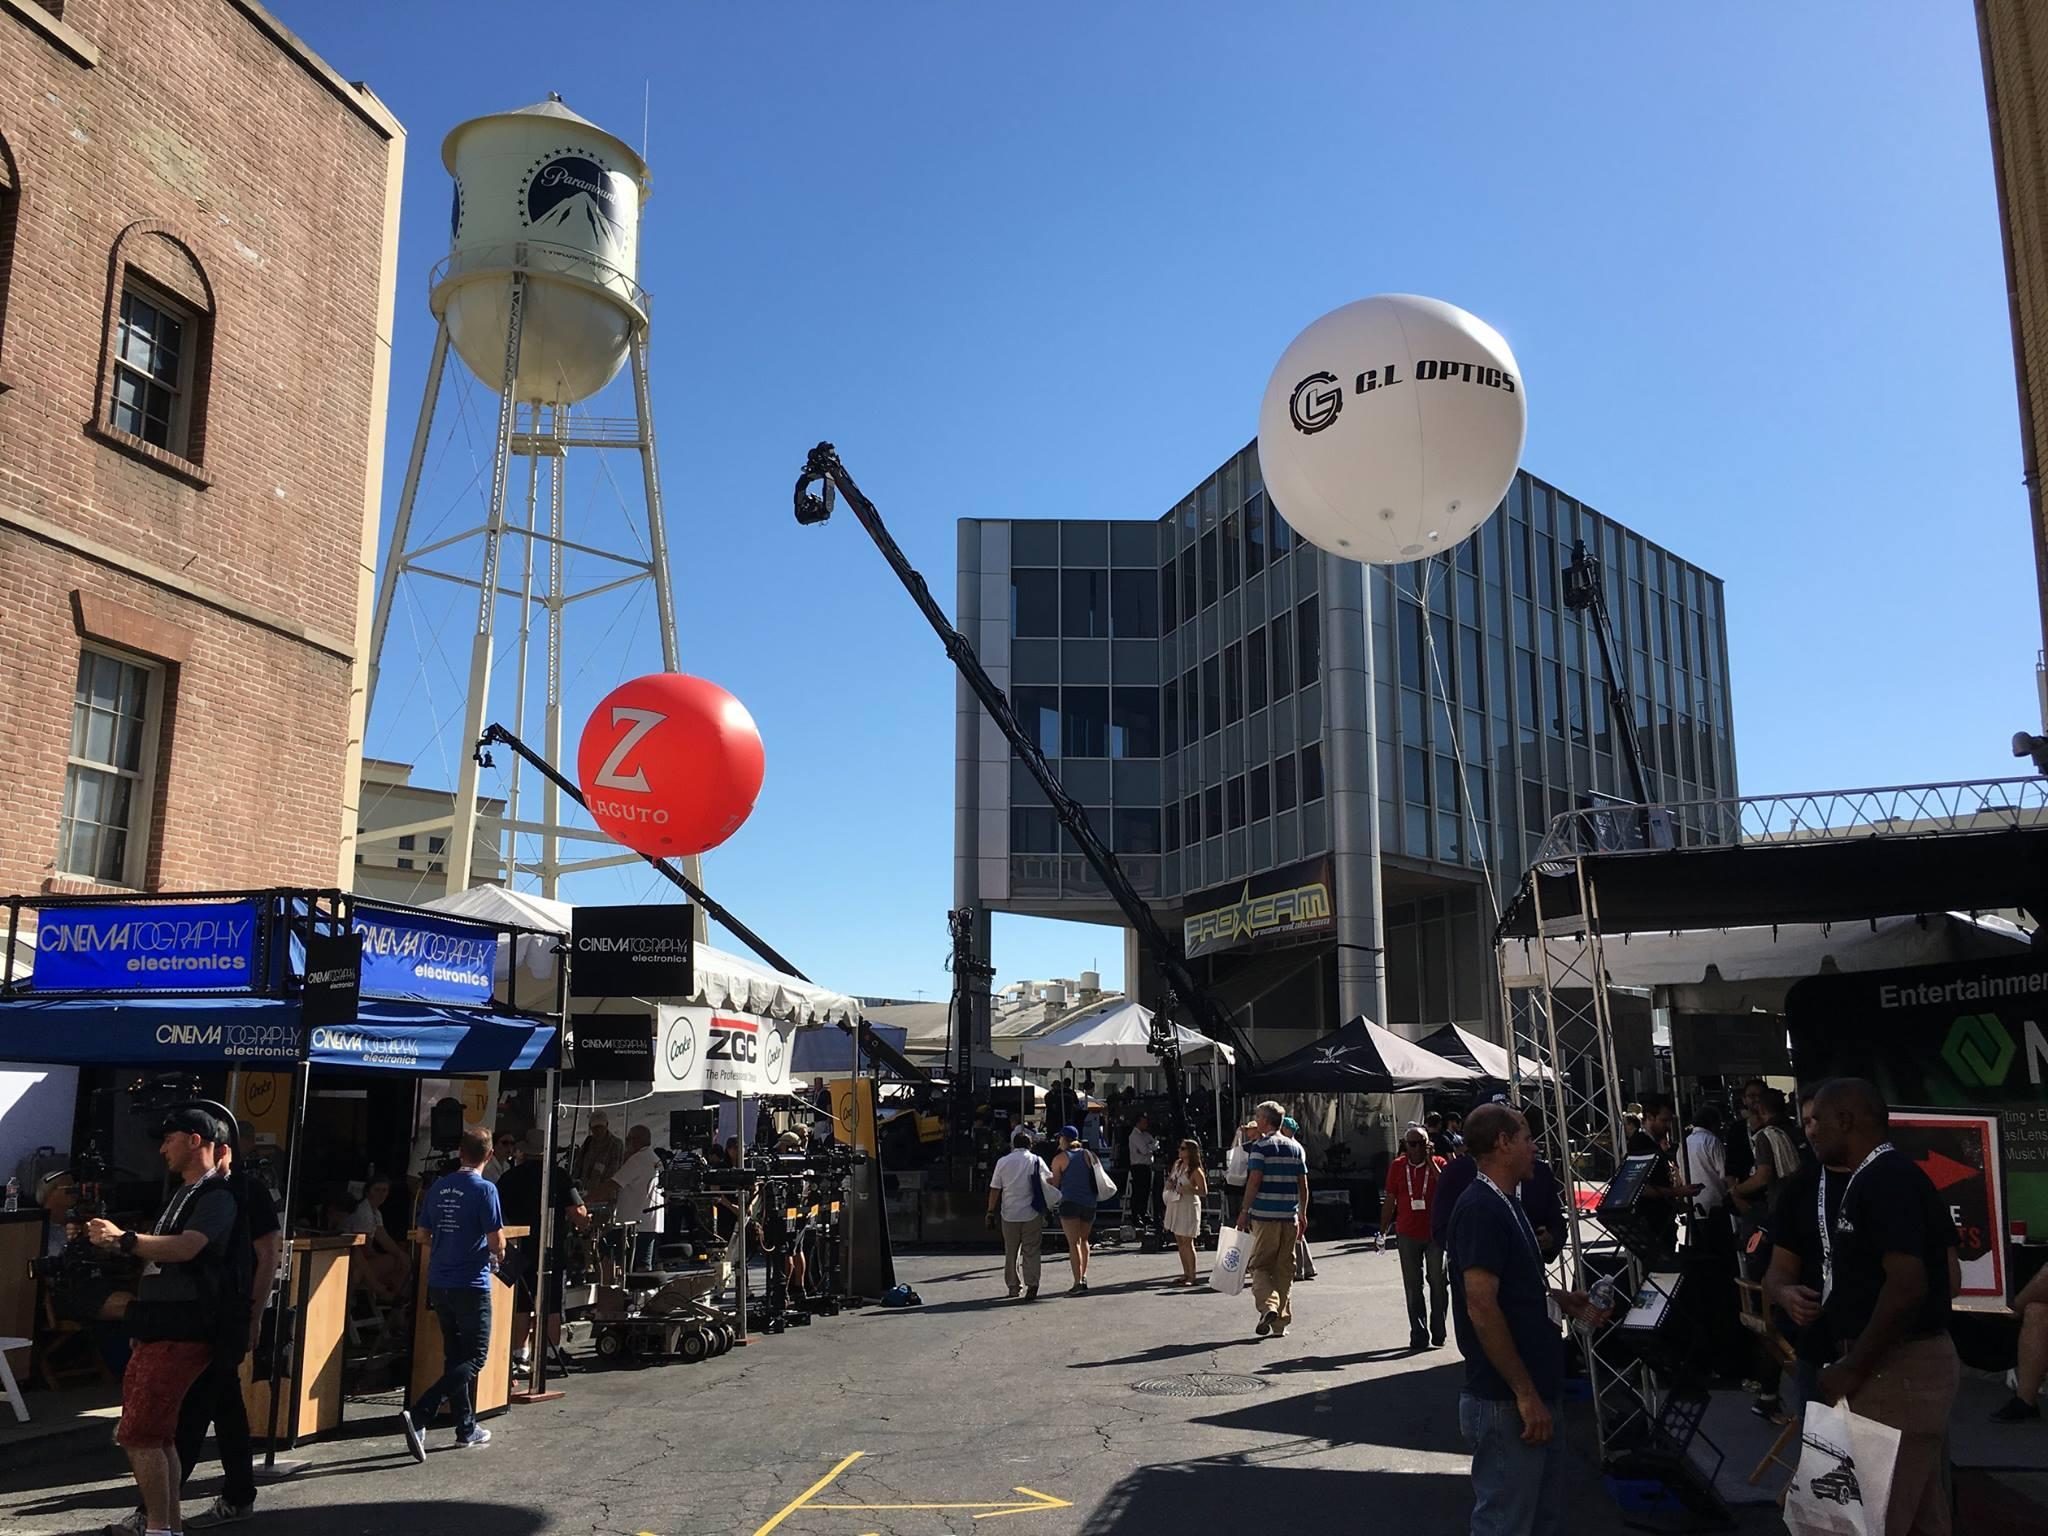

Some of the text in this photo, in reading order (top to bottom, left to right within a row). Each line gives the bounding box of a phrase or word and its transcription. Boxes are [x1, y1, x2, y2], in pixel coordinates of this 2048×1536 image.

[540, 165, 617, 205] Paramount
[1355, 359, 1515, 395] G.L OPTICS
[593, 706, 670, 793] Z
[39, 919, 249, 953] CINEMATOGRAPHY
[354, 921, 492, 969] CINEMATOGRAPHY
[579, 937, 688, 953] CINEMATOGRAPHY
[126, 954, 246, 973] electronics
[631, 953, 688, 963] electronics
[414, 960, 490, 988] electronics
[156, 1024, 302, 1046] CINEMATOGRAPHY
[312, 1027, 418, 1057] CINEMATOGRAPHY
[670, 1035, 692, 1062] Cooke
[705, 1028, 757, 1064] ZGC
[223, 1045, 301, 1058] electronics
[362, 1053, 417, 1066] electronics
[706, 1068, 719, 1081] The
[2006, 1109, 2026, 1126] ting
